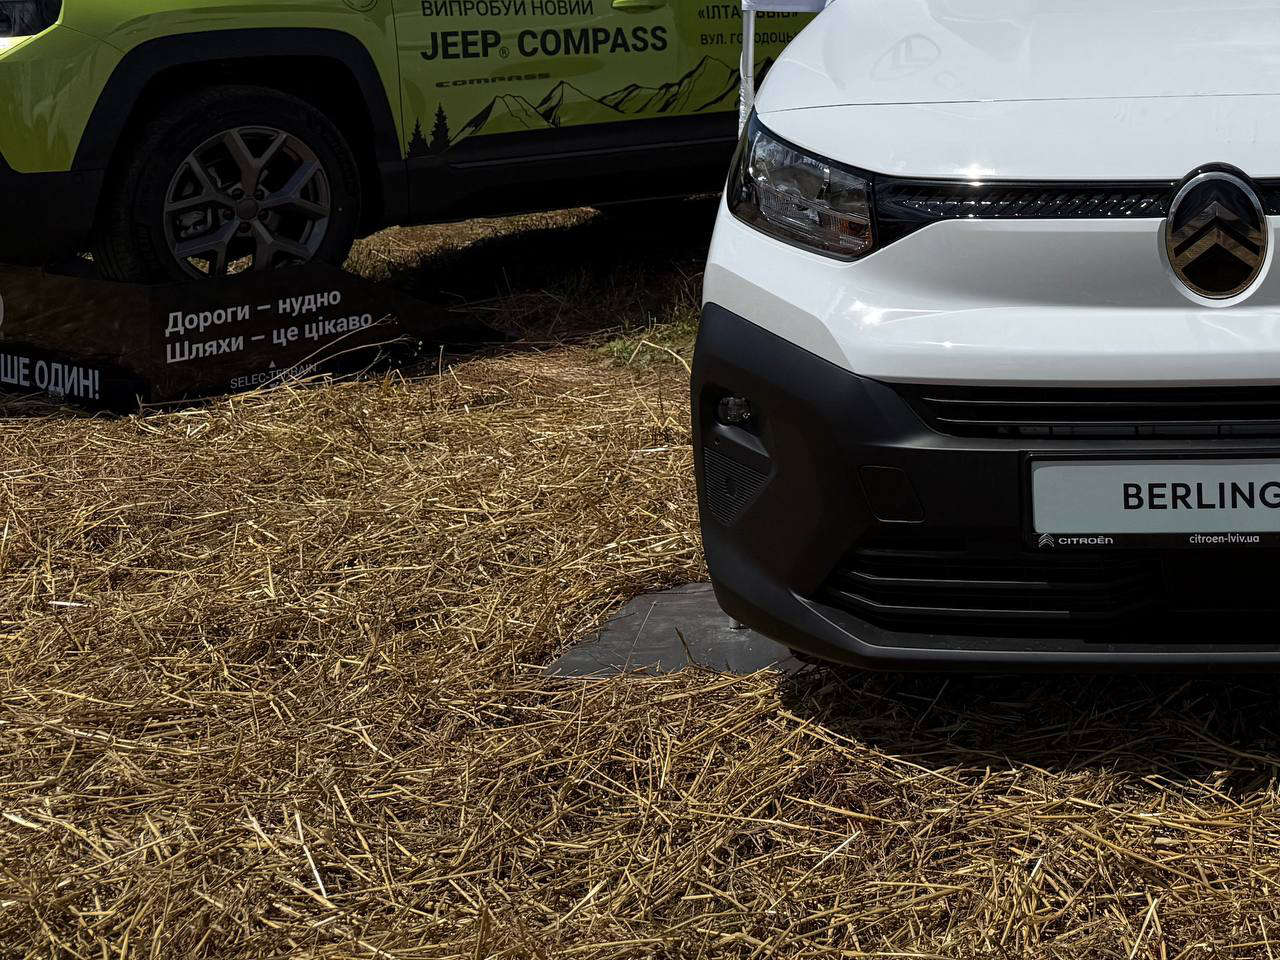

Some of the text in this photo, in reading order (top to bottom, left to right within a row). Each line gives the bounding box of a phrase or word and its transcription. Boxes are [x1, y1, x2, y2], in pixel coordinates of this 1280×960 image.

[517, 26, 668, 57] COMPASS
[165, 303, 251, 337] Дороги
[278, 291, 342, 316] нудно
[166, 335, 245, 364] Шляхи
[272, 325, 299, 346] це
[304, 312, 373, 340] цікаво
[34, 360, 100, 400] ОДИН!
[1058, 534, 1114, 546] CITROËN
[1189, 533, 1260, 545] citroen-lviv.ua
